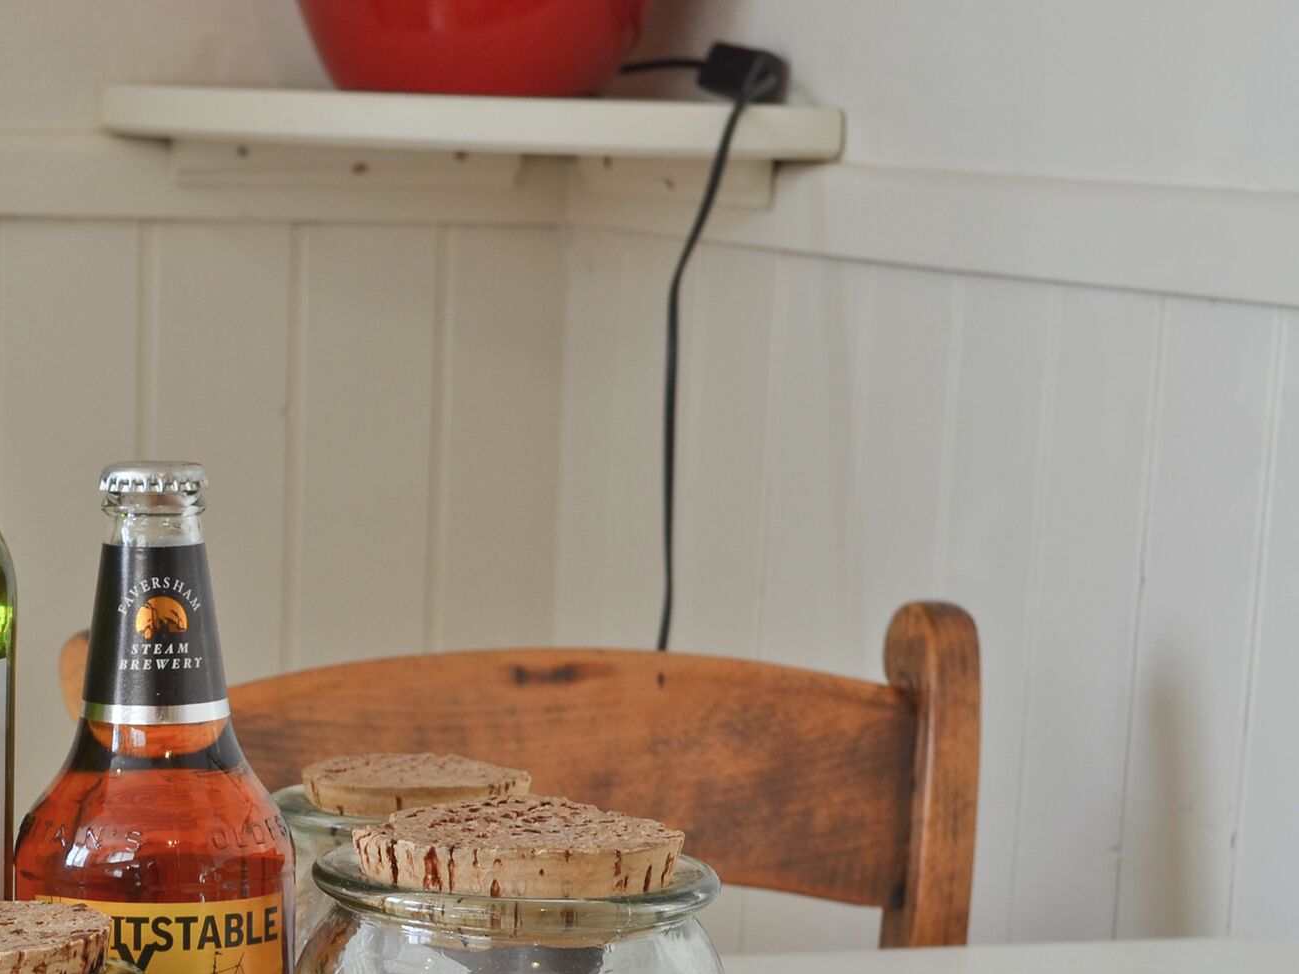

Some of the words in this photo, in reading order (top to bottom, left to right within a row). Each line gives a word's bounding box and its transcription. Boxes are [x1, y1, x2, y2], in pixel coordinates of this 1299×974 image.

[118, 577, 201, 614] FAVERSHAM
[131, 642, 189, 655] STEAM
[119, 657, 202, 671] BREWERY
[110, 906, 278, 952] ITSTABLE
